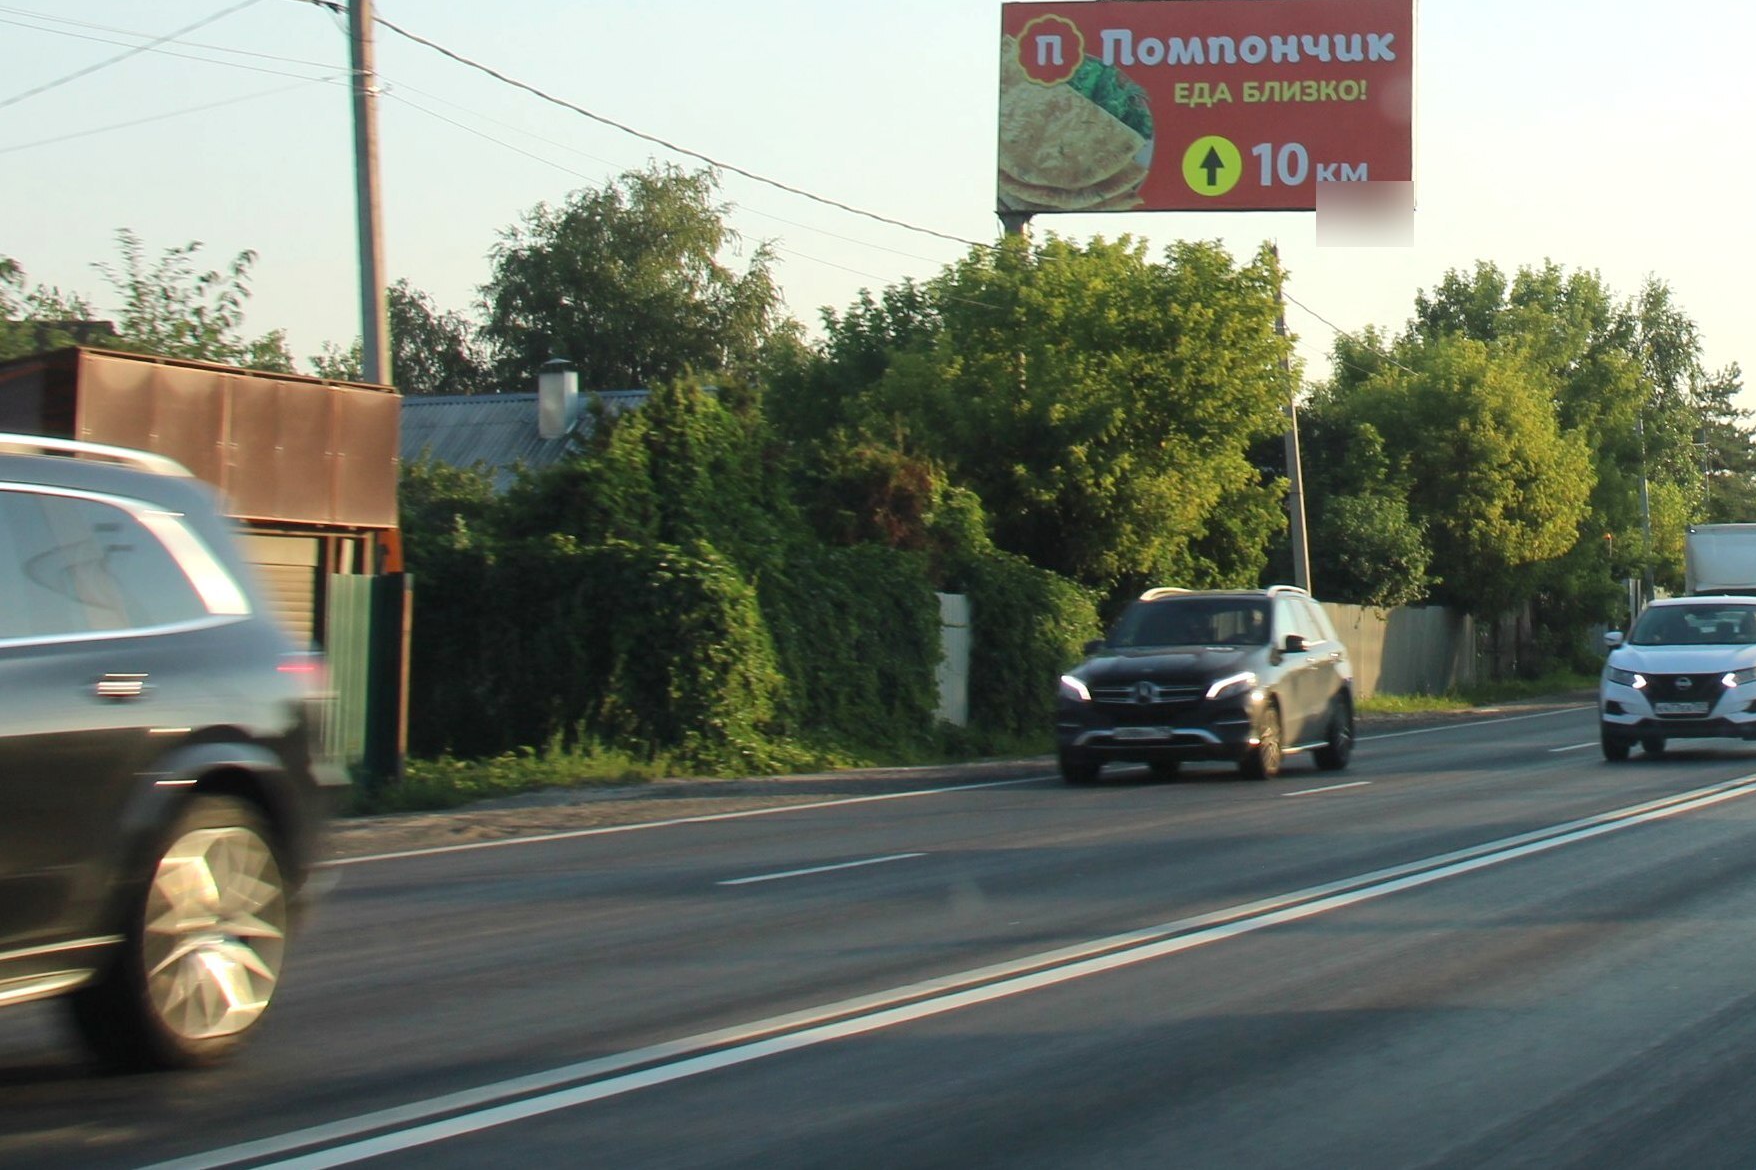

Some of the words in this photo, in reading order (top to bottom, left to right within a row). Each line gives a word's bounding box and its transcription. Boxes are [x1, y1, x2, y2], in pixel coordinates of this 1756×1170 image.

[1099, 28, 1396, 66] Помпончик
[1173, 81, 1233, 108] ЕДА
[1242, 79, 1368, 105] БЛИЗКО!
[1251, 142, 1309, 187] 10
